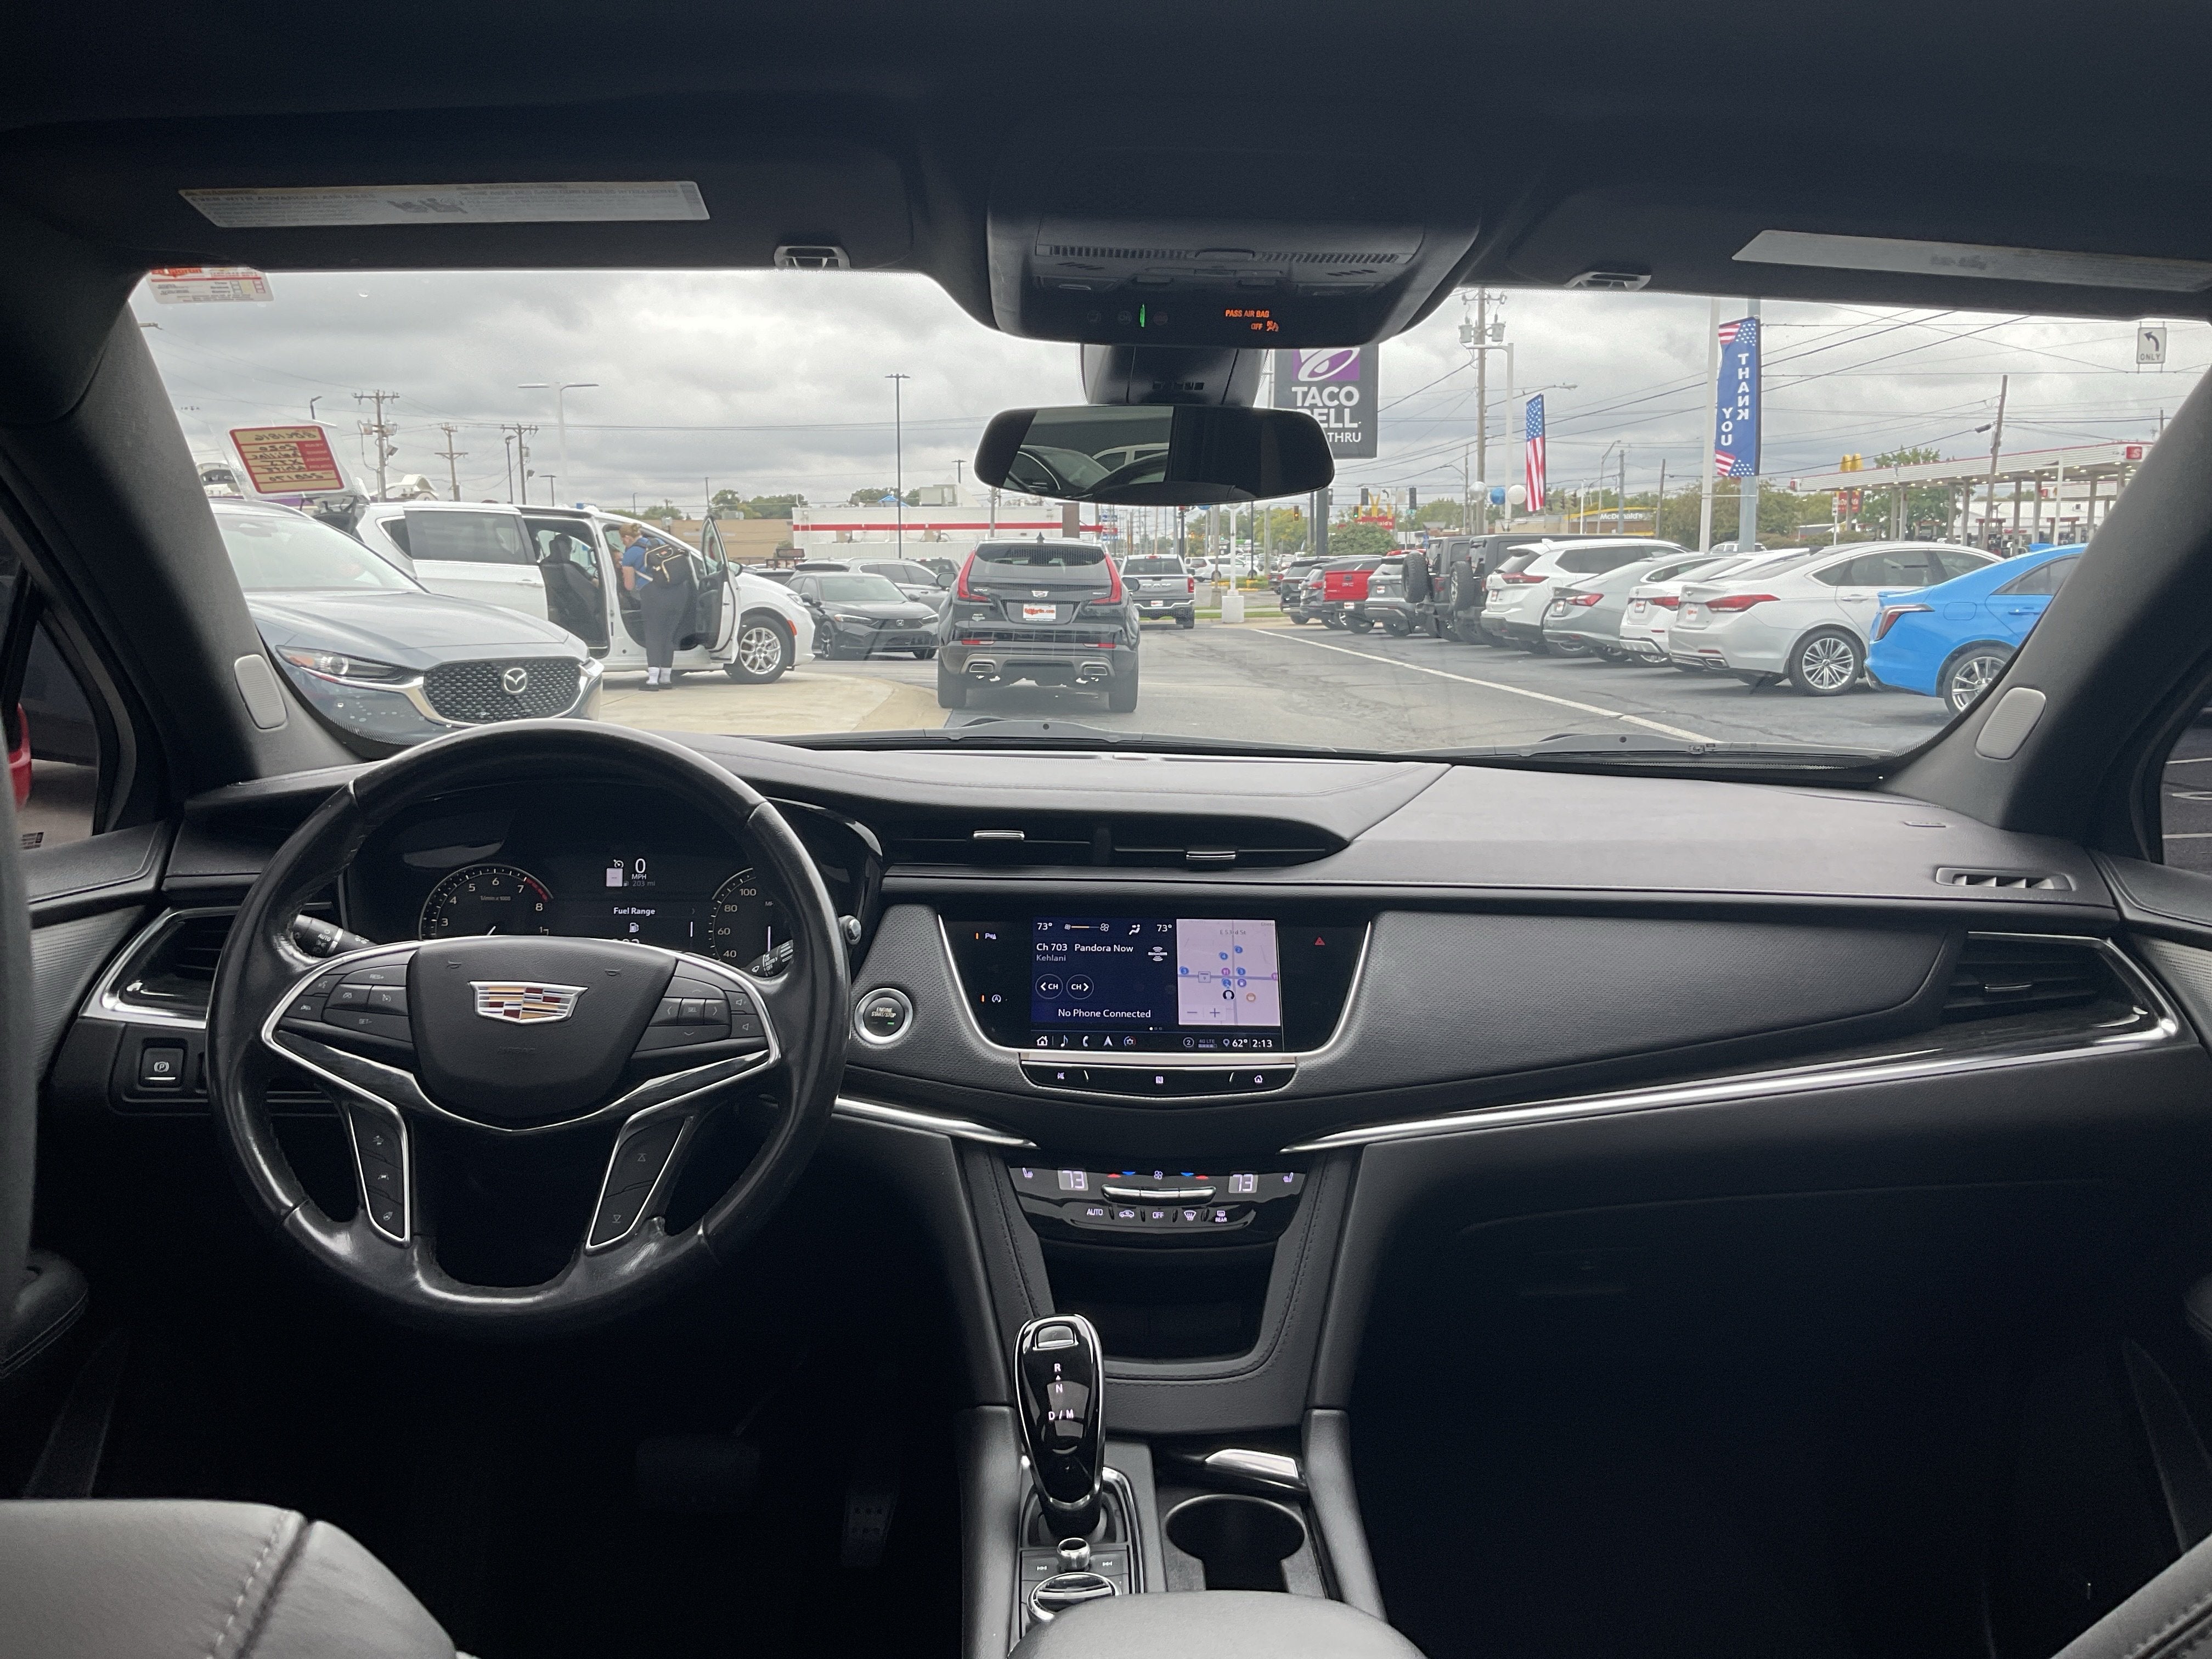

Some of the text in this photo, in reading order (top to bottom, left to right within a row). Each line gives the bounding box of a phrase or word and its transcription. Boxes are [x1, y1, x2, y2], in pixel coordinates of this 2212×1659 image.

[1225, 309, 1242, 318] PASS
[1291, 386, 1359, 407] TACO
[1297, 408, 1358, 428] ELL
[1327, 432, 1361, 443] THRU
[635, 858, 646, 873] 0
[517, 885, 524, 893] 7
[450, 896, 457, 904] 4
[535, 903, 543, 911] 8
[631, 907, 656, 916] Range
[1037, 922, 1053, 930] 73°
[1156, 924, 1172, 932] 73°
[318, 934, 331, 942] AUTO
[1036, 943, 1048, 951] Ch
[1074, 944, 1111, 952] Pandora
[1113, 944, 1134, 952] Now
[1073, 1009, 1101, 1017] Phone
[1103, 1009, 1151, 1018] Connected
[1232, 1039, 1248, 1047] 62°
[1252, 1039, 1272, 1047] 2:13
[1062, 1170, 1085, 1189] 73
[1232, 1173, 1254, 1192] 73
[1054, 1363, 1062, 1372] R
[1056, 1384, 1063, 1393] N
